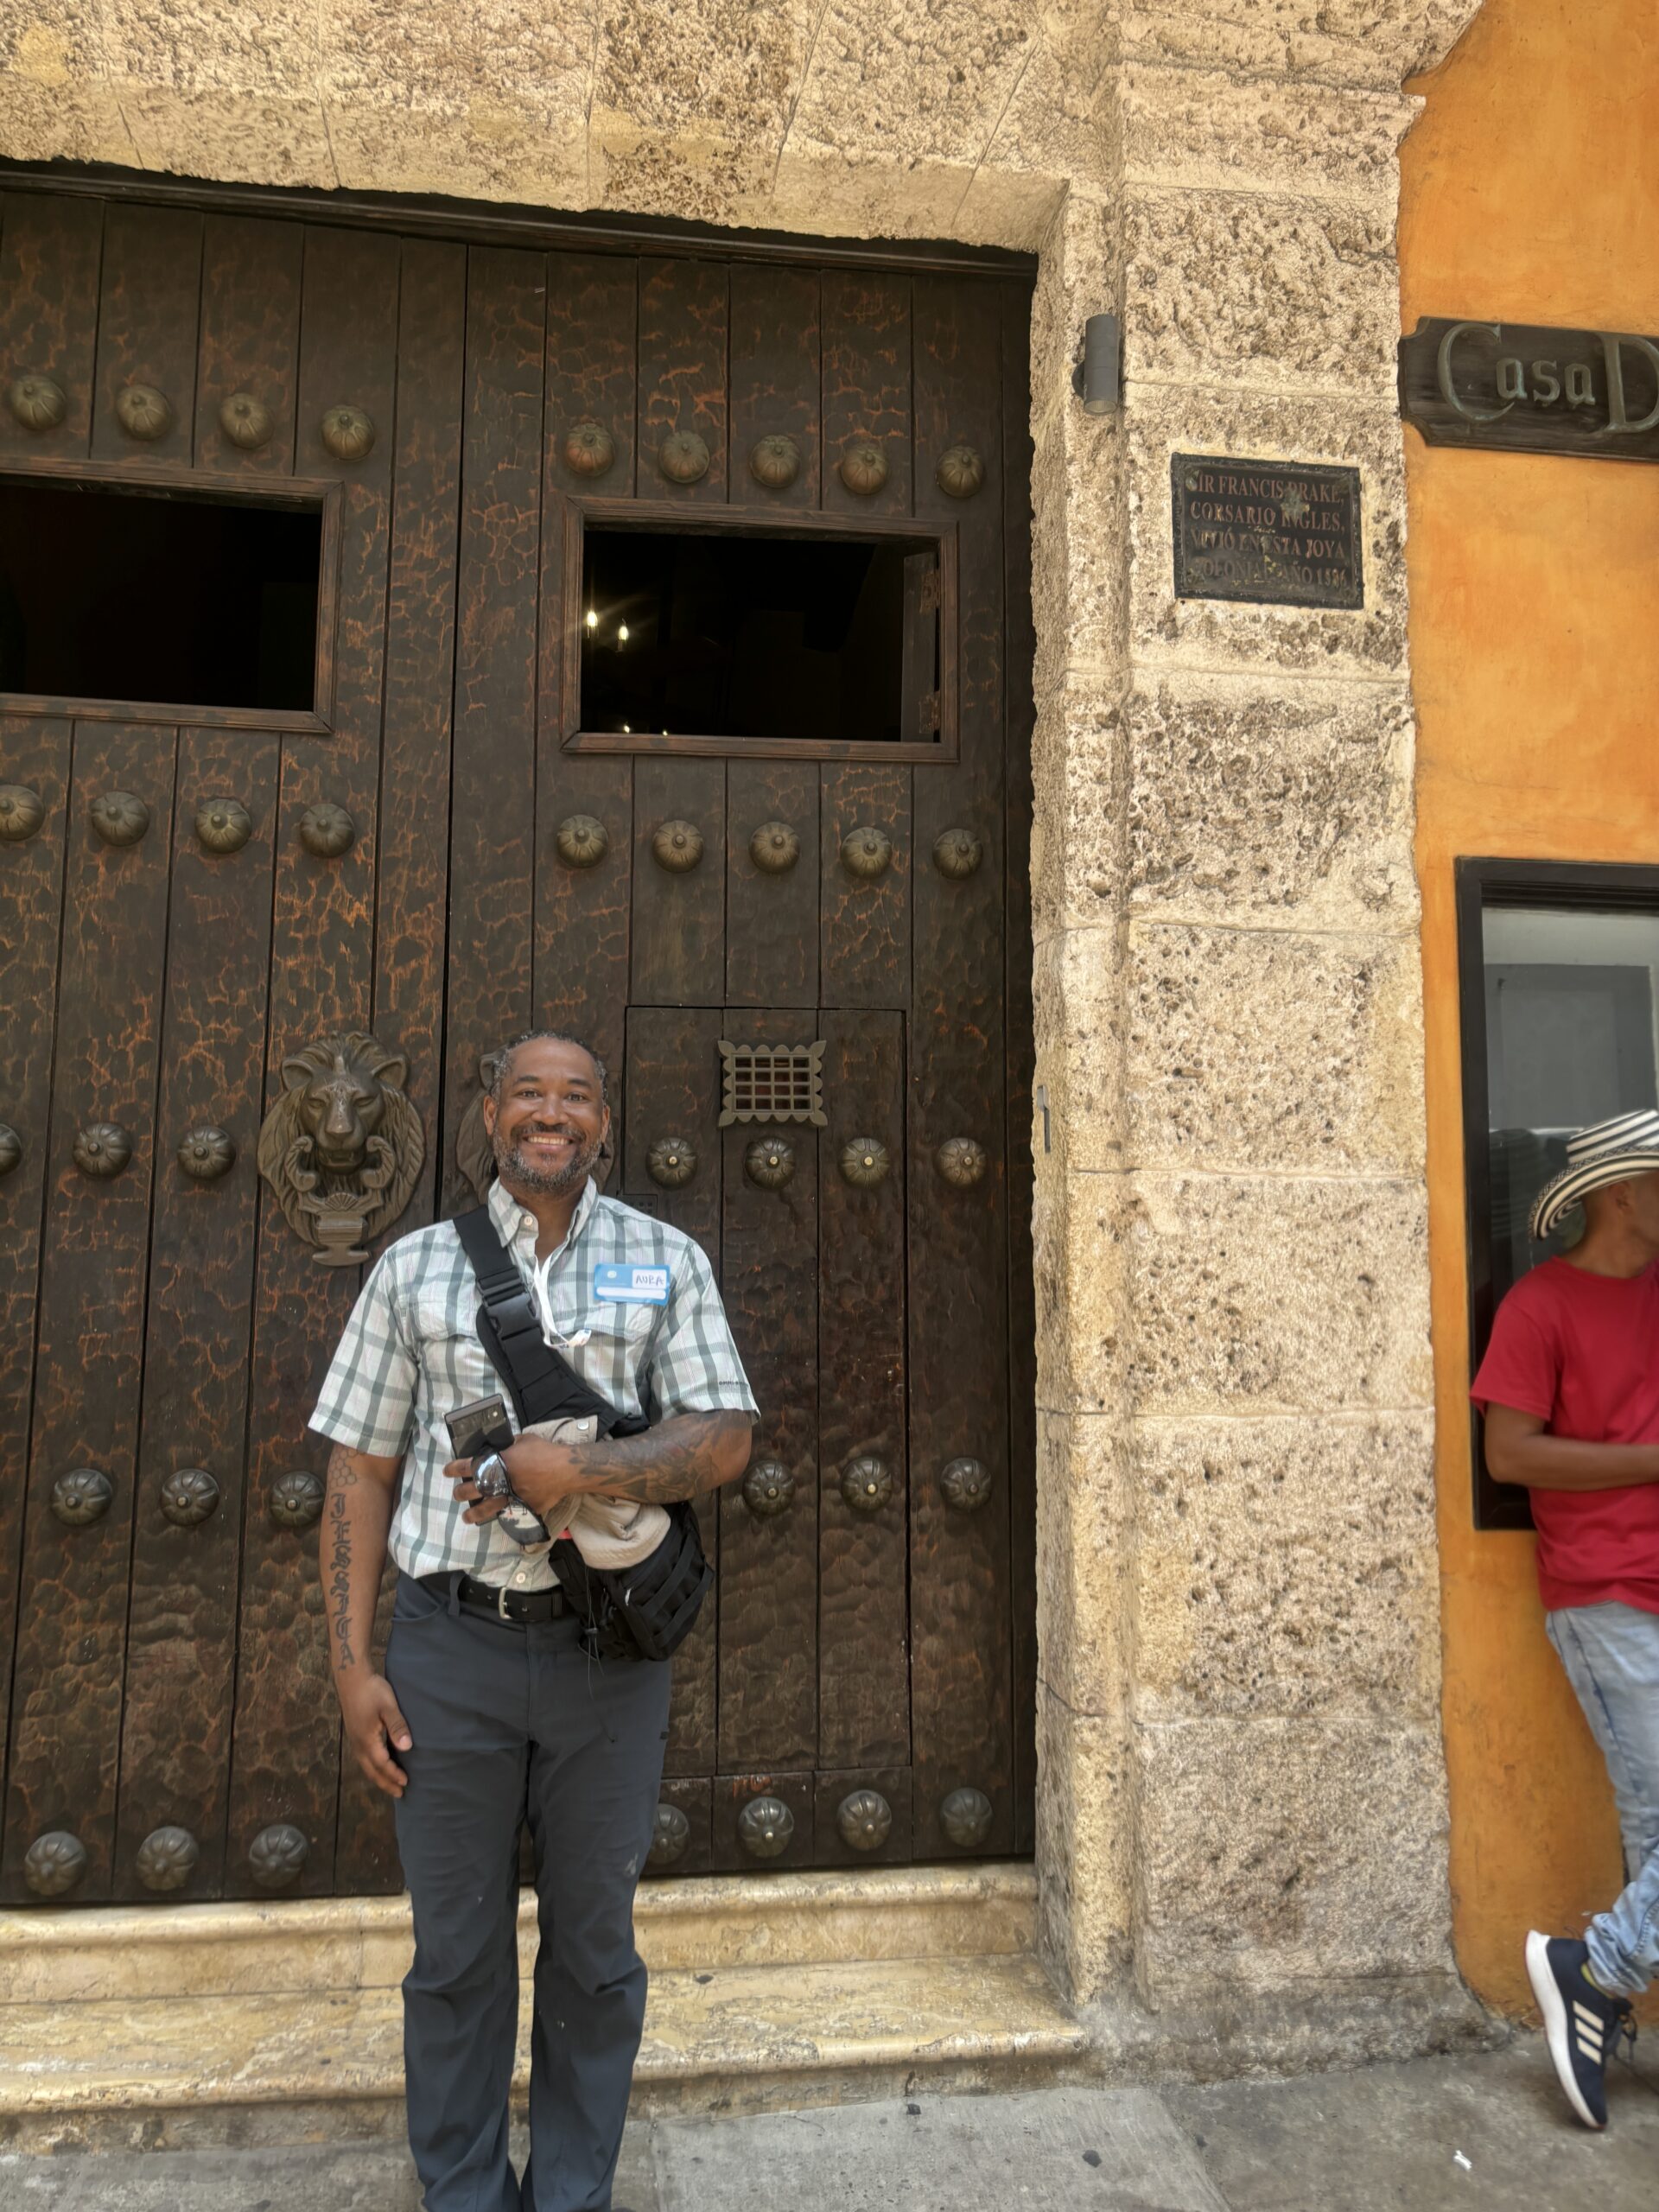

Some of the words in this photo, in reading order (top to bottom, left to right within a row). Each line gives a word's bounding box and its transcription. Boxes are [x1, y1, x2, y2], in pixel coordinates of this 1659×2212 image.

[1437, 321, 1595, 423] Casa
[1186, 472, 1215, 493] IR
[1219, 475, 1283, 499] FRANCIS
[1191, 501, 1275, 525] CORSARIO
[1281, 510, 1345, 534] INGLES,
[1306, 538, 1345, 559] JOYA
[330, 1493, 355, 1670] JESSICA
